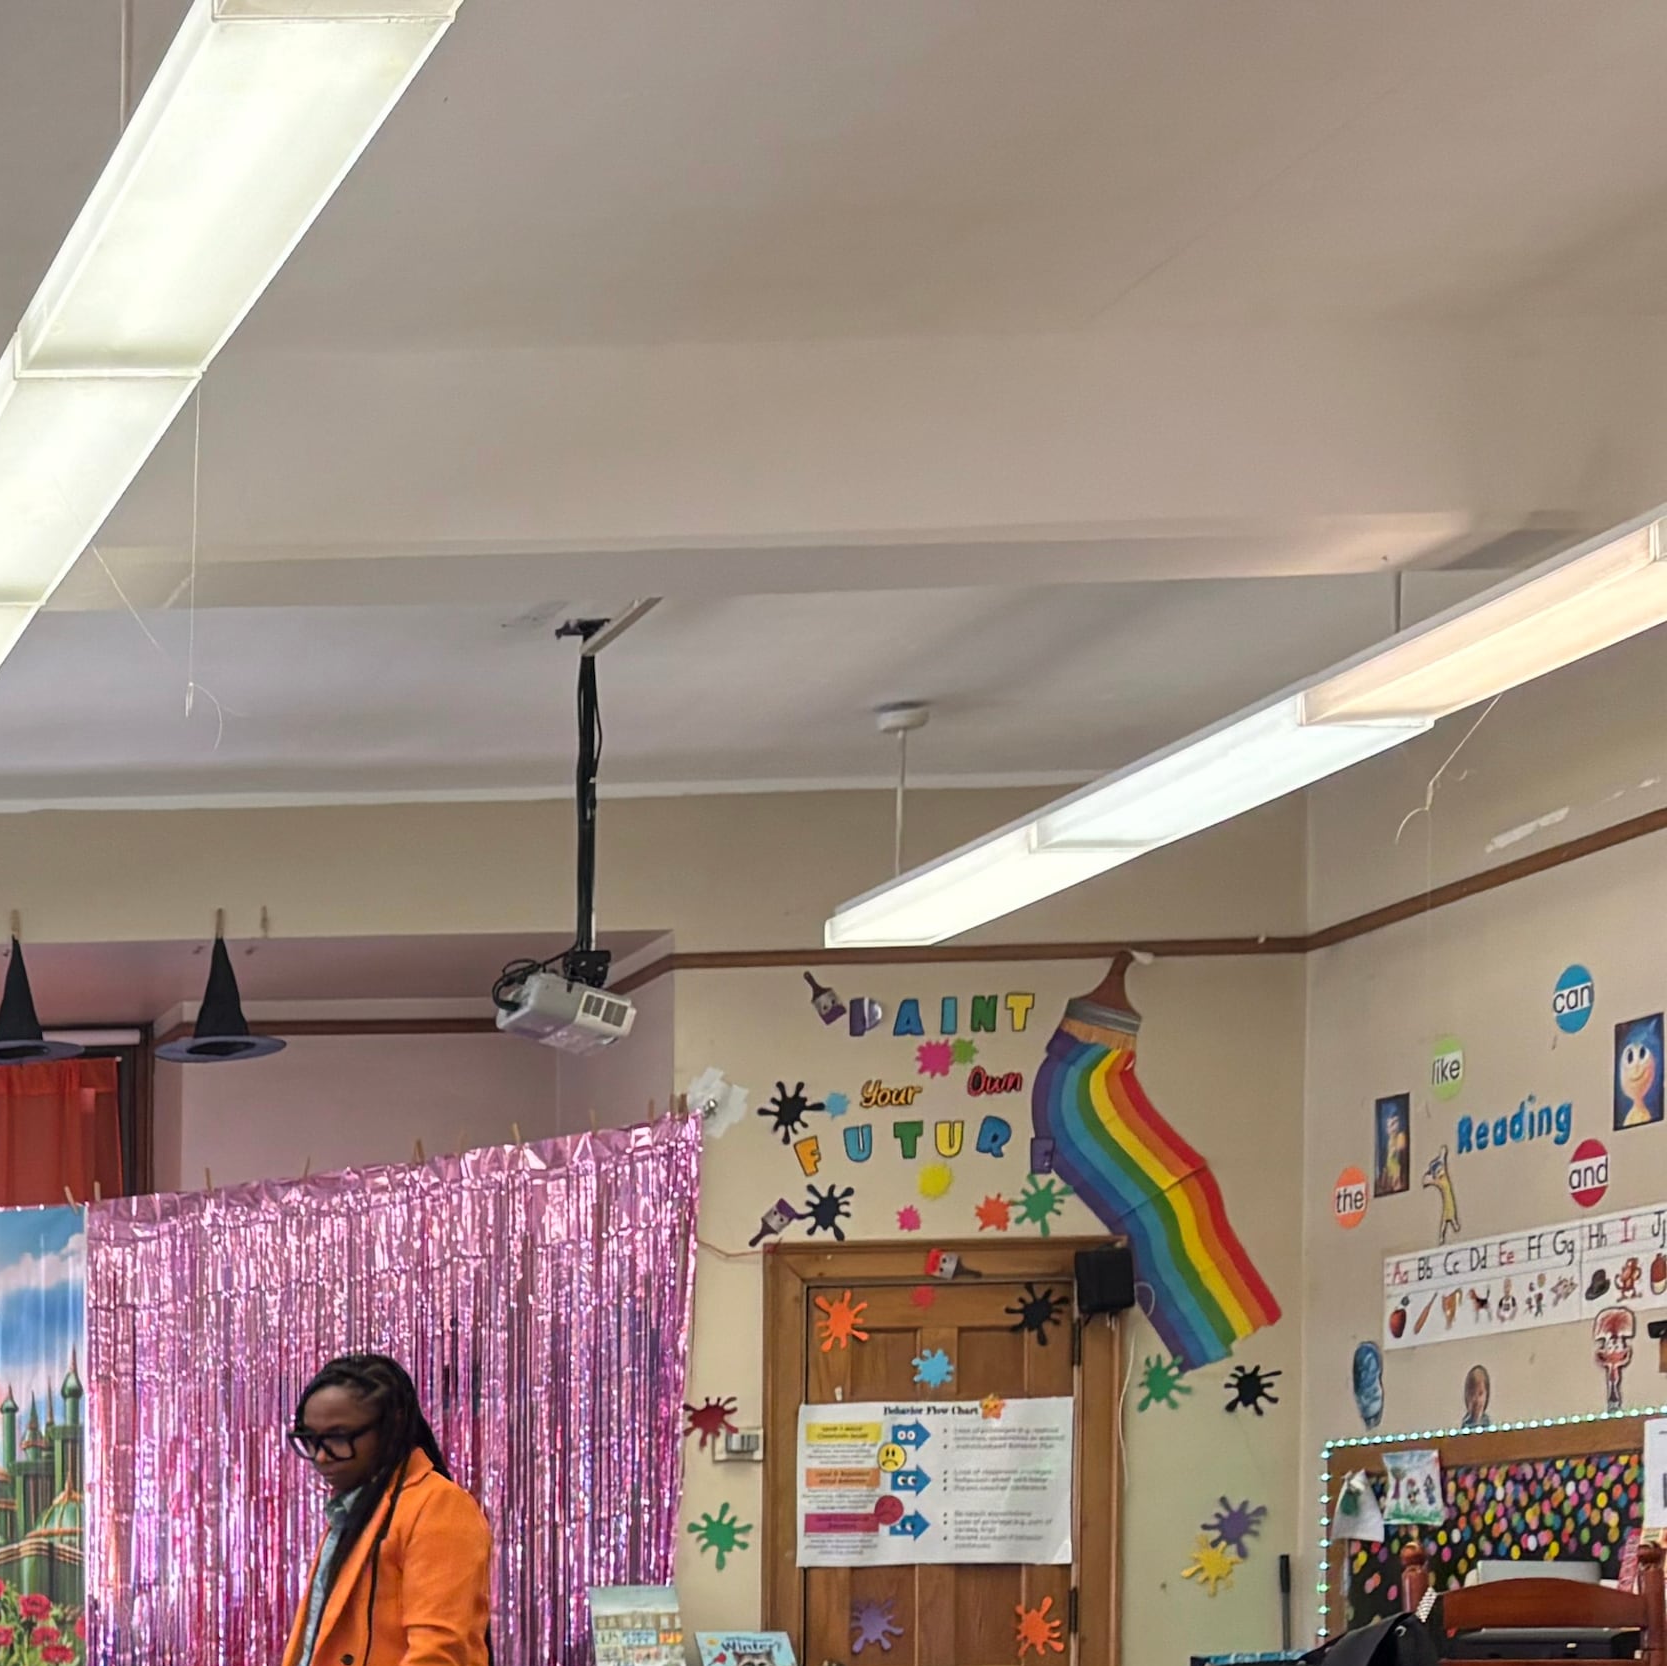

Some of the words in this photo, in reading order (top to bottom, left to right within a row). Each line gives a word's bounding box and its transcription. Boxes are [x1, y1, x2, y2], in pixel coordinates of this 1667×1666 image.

[848, 992, 1036, 1037] PAINT
[1552, 983, 1593, 1016] can
[859, 1079, 924, 1109] Your
[967, 1064, 1023, 1097] Own
[1431, 1056, 1461, 1086] like
[1456, 1092, 1573, 1155] Reading
[793, 1114, 1056, 1178] FUTURE
[1568, 1155, 1609, 1190] and
[1335, 1185, 1365, 1214] the
[1393, 1260, 1409, 1285] Aa
[1418, 1256, 1433, 1281] Bb
[1443, 1251, 1460, 1276] Cc
[1469, 1244, 1488, 1271] Dd
[1498, 1240, 1515, 1266] Ee
[1527, 1232, 1545, 1261] Ff
[1553, 1229, 1575, 1267] Gg
[1588, 1222, 1608, 1250] Hh
[1619, 1215, 1637, 1244] Ii
[883, 1404, 923, 1416] Behavior
[926, 1404, 950, 1416] Flow
[951, 1404, 979, 1416] Chart
